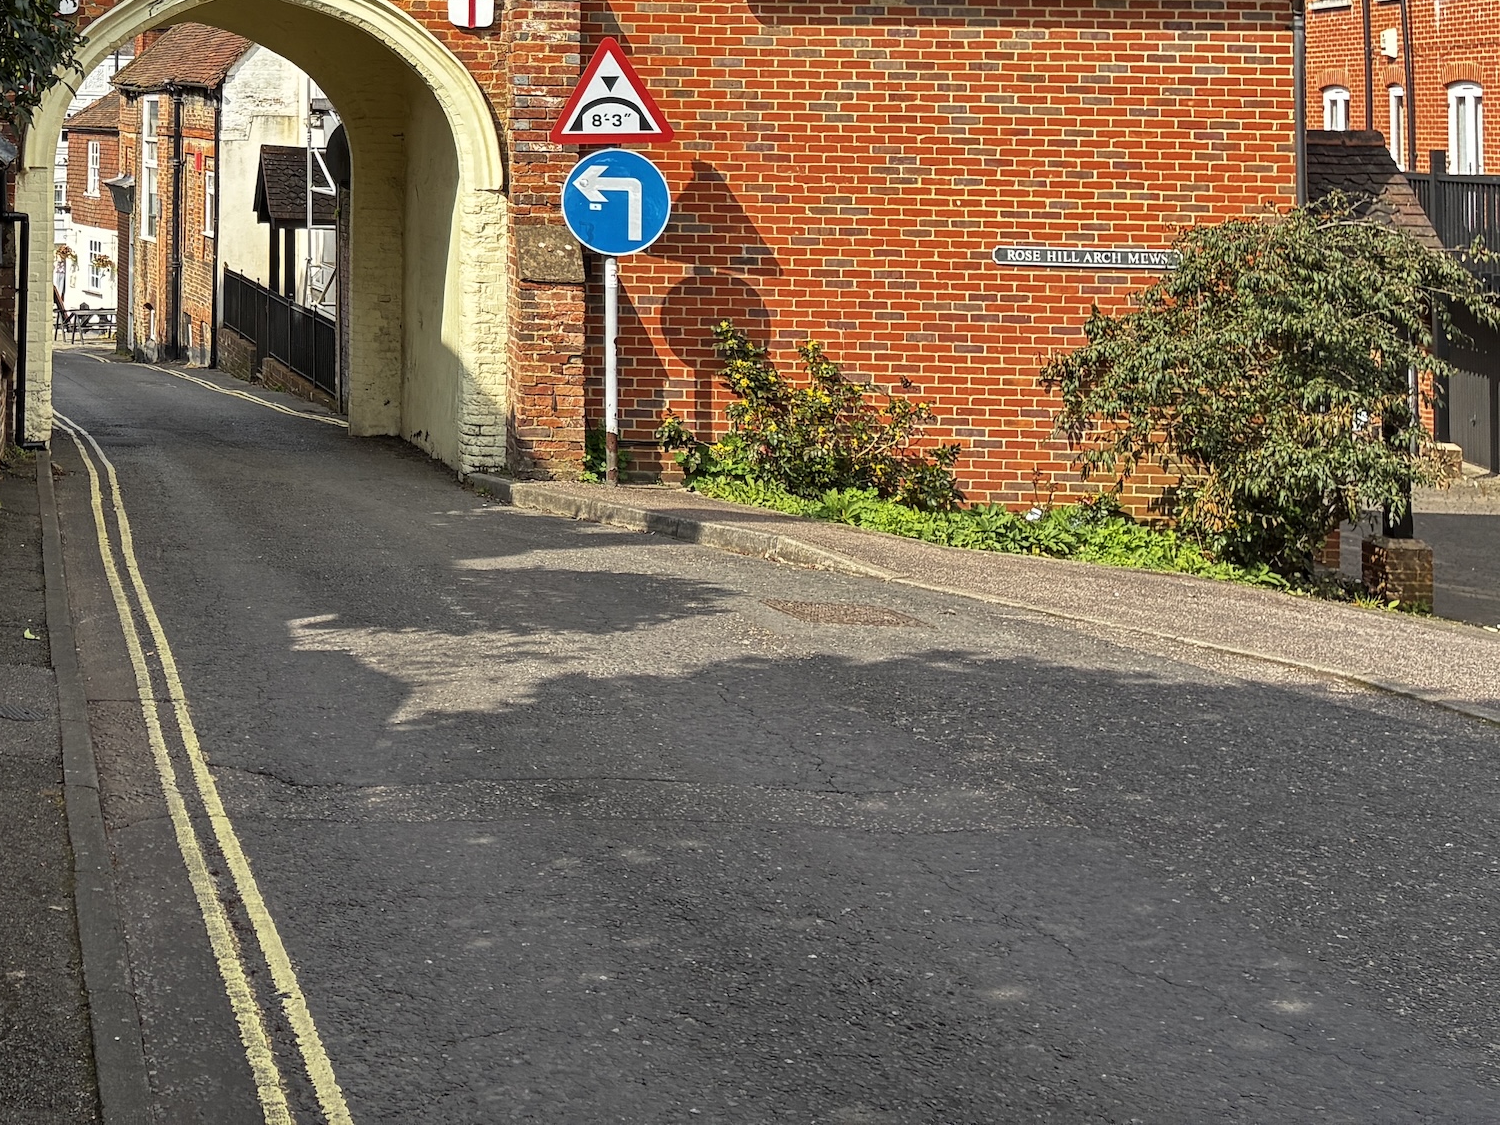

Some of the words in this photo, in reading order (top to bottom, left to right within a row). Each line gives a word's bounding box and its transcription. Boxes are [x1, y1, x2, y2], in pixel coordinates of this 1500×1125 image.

[1007, 249, 1041, 262] ROSE
[1047, 250, 1080, 263] HILL
[1083, 251, 1122, 264] ARCH
[1128, 252, 1168, 264] MEWS
